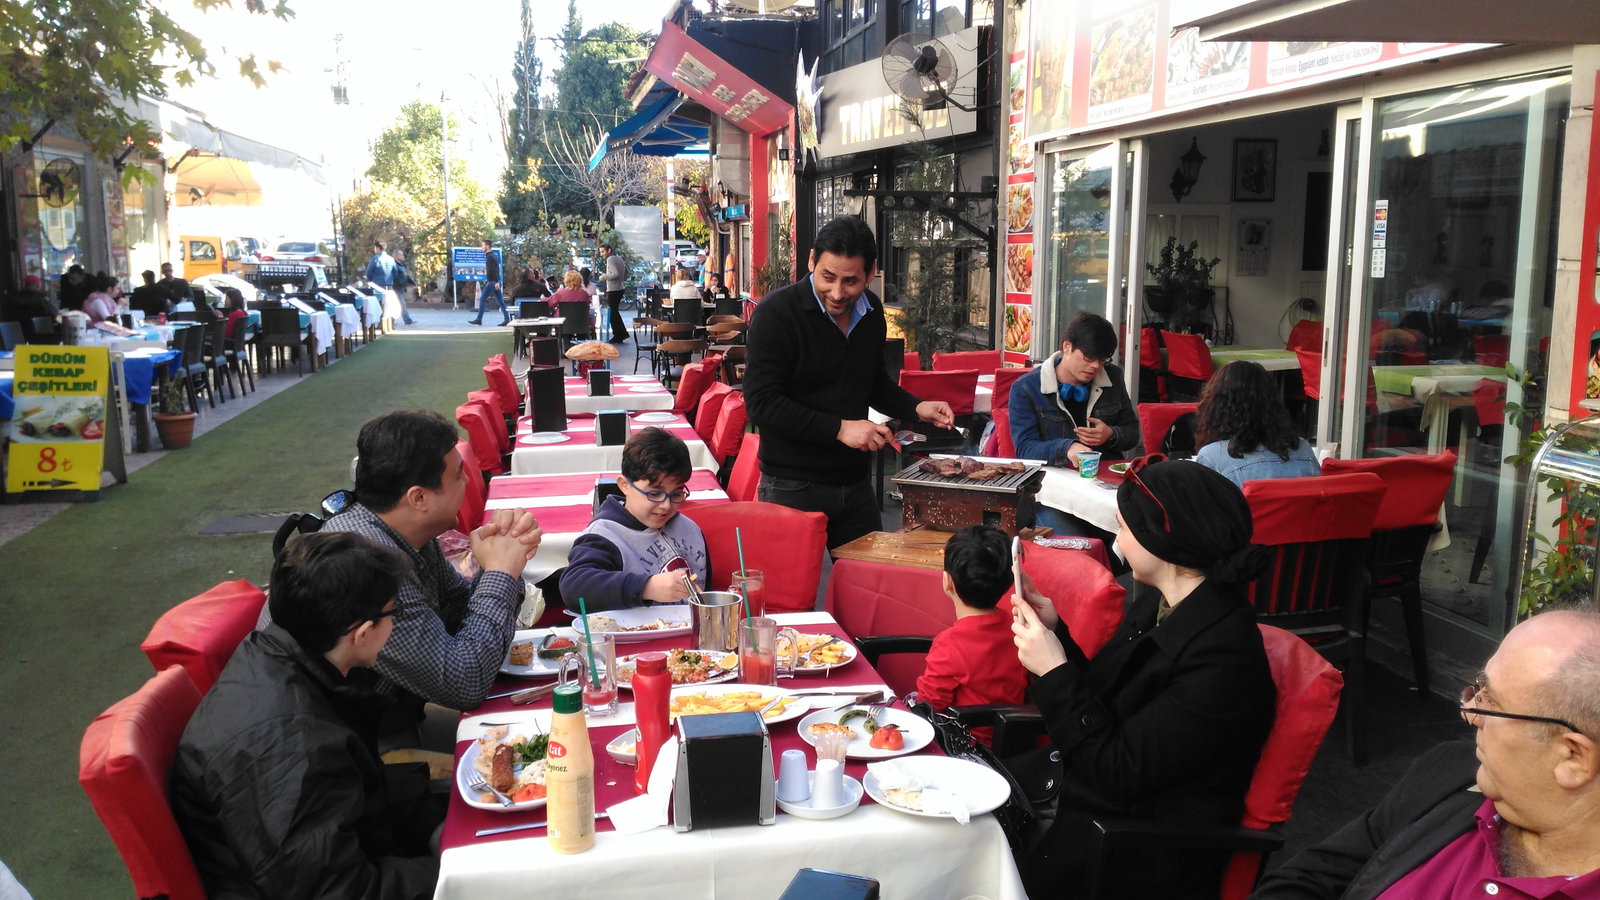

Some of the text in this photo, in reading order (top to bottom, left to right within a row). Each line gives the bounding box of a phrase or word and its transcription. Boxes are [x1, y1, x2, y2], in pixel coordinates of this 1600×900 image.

[29, 353, 86, 364] DÜRÜM
[33, 367, 85, 378] KEBAP
[17, 380, 97, 393] ÇEŞİTLERİ
[37, 447, 58, 473] 8
